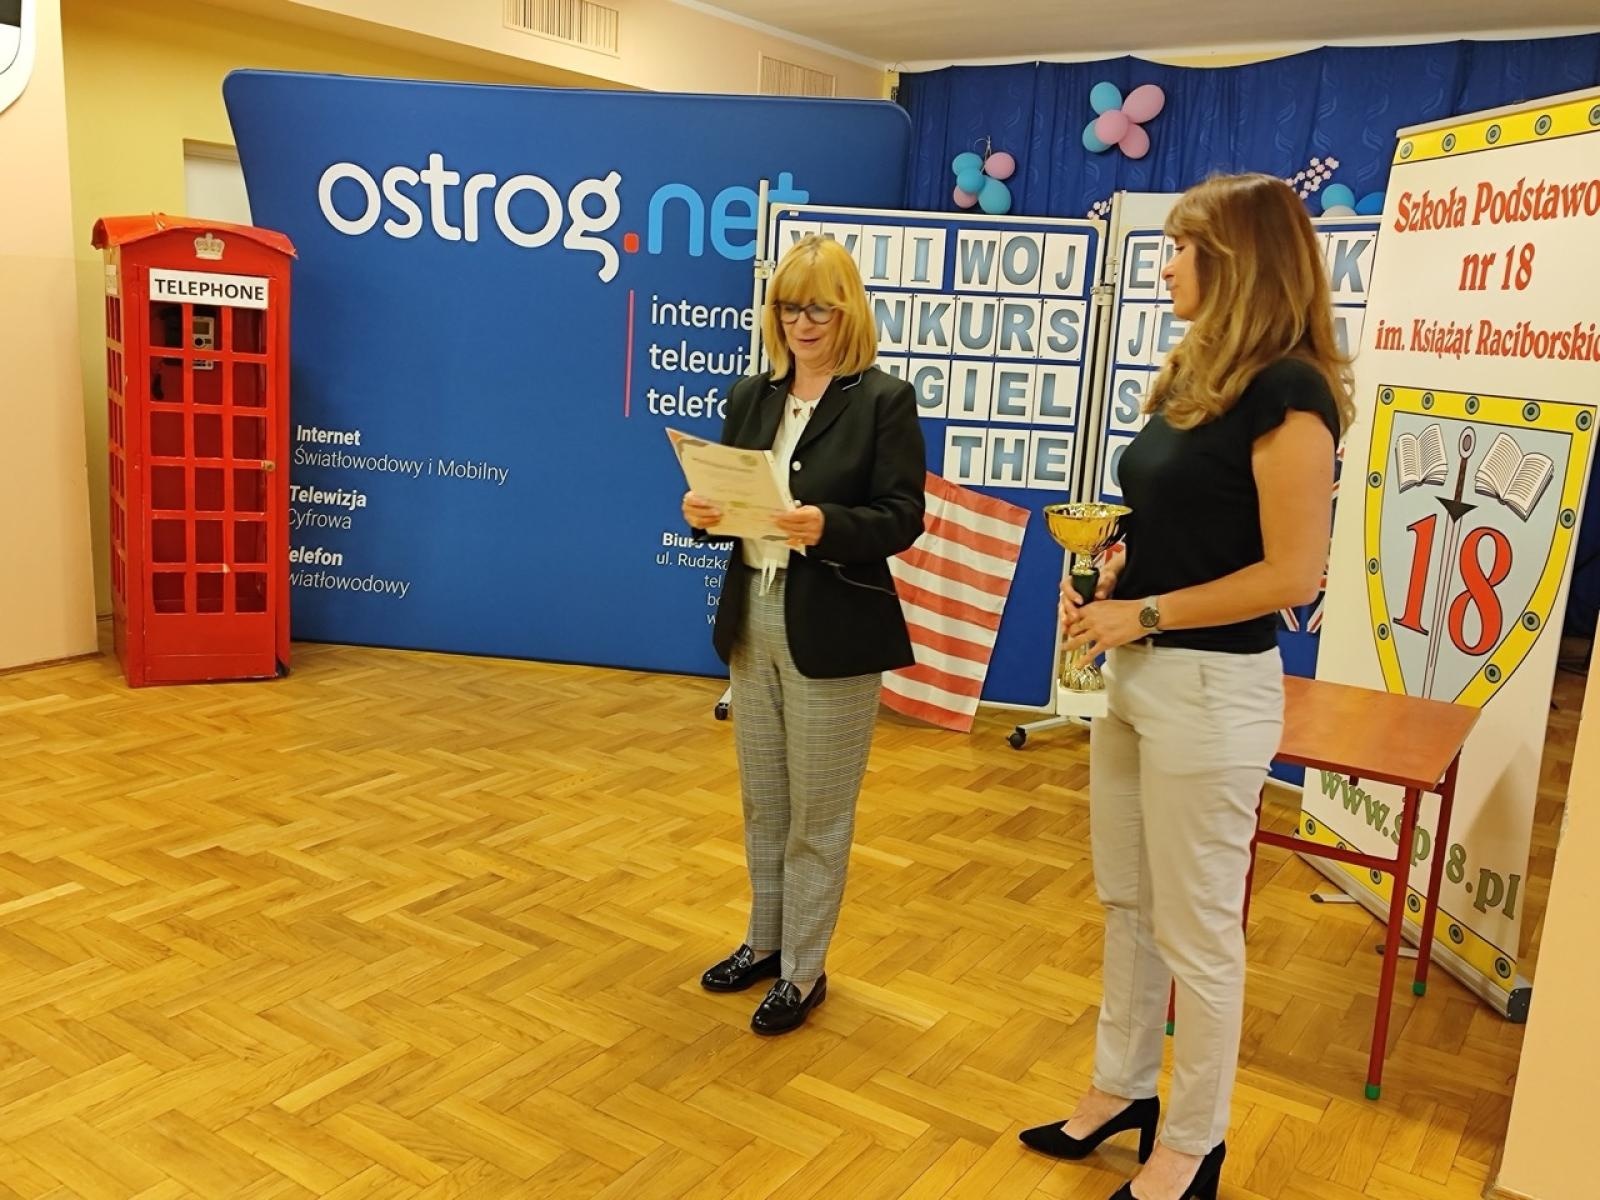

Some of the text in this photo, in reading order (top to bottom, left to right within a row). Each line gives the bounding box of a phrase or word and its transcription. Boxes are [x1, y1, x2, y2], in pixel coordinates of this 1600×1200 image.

[1394, 176, 1600, 233] Szkoła Podstawo
[960, 236, 1076, 290] WOJ
[1458, 242, 1536, 291] nr 18
[154, 277, 266, 301] TELEPHONE
[651, 294, 754, 331] interne
[875, 298, 1079, 353] NKURS
[1375, 319, 1405, 350] im.
[1410, 318, 1473, 360] Książąt
[649, 340, 753, 376] telewi
[647, 386, 728, 419] telefo
[296, 425, 361, 446] Internet
[294, 444, 509, 486] Światłowodowy i Mobilny
[950, 435, 1070, 482] THE
[290, 485, 367, 511] Telewizja
[288, 508, 352, 530] Cyfrowa
[288, 546, 343, 567] elefon
[656, 551, 673, 566] ul.
[289, 569, 410, 600] wiatłowodowy
[1393, 513, 1513, 657] 18
[1319, 769, 1520, 920] www.p8.pl
